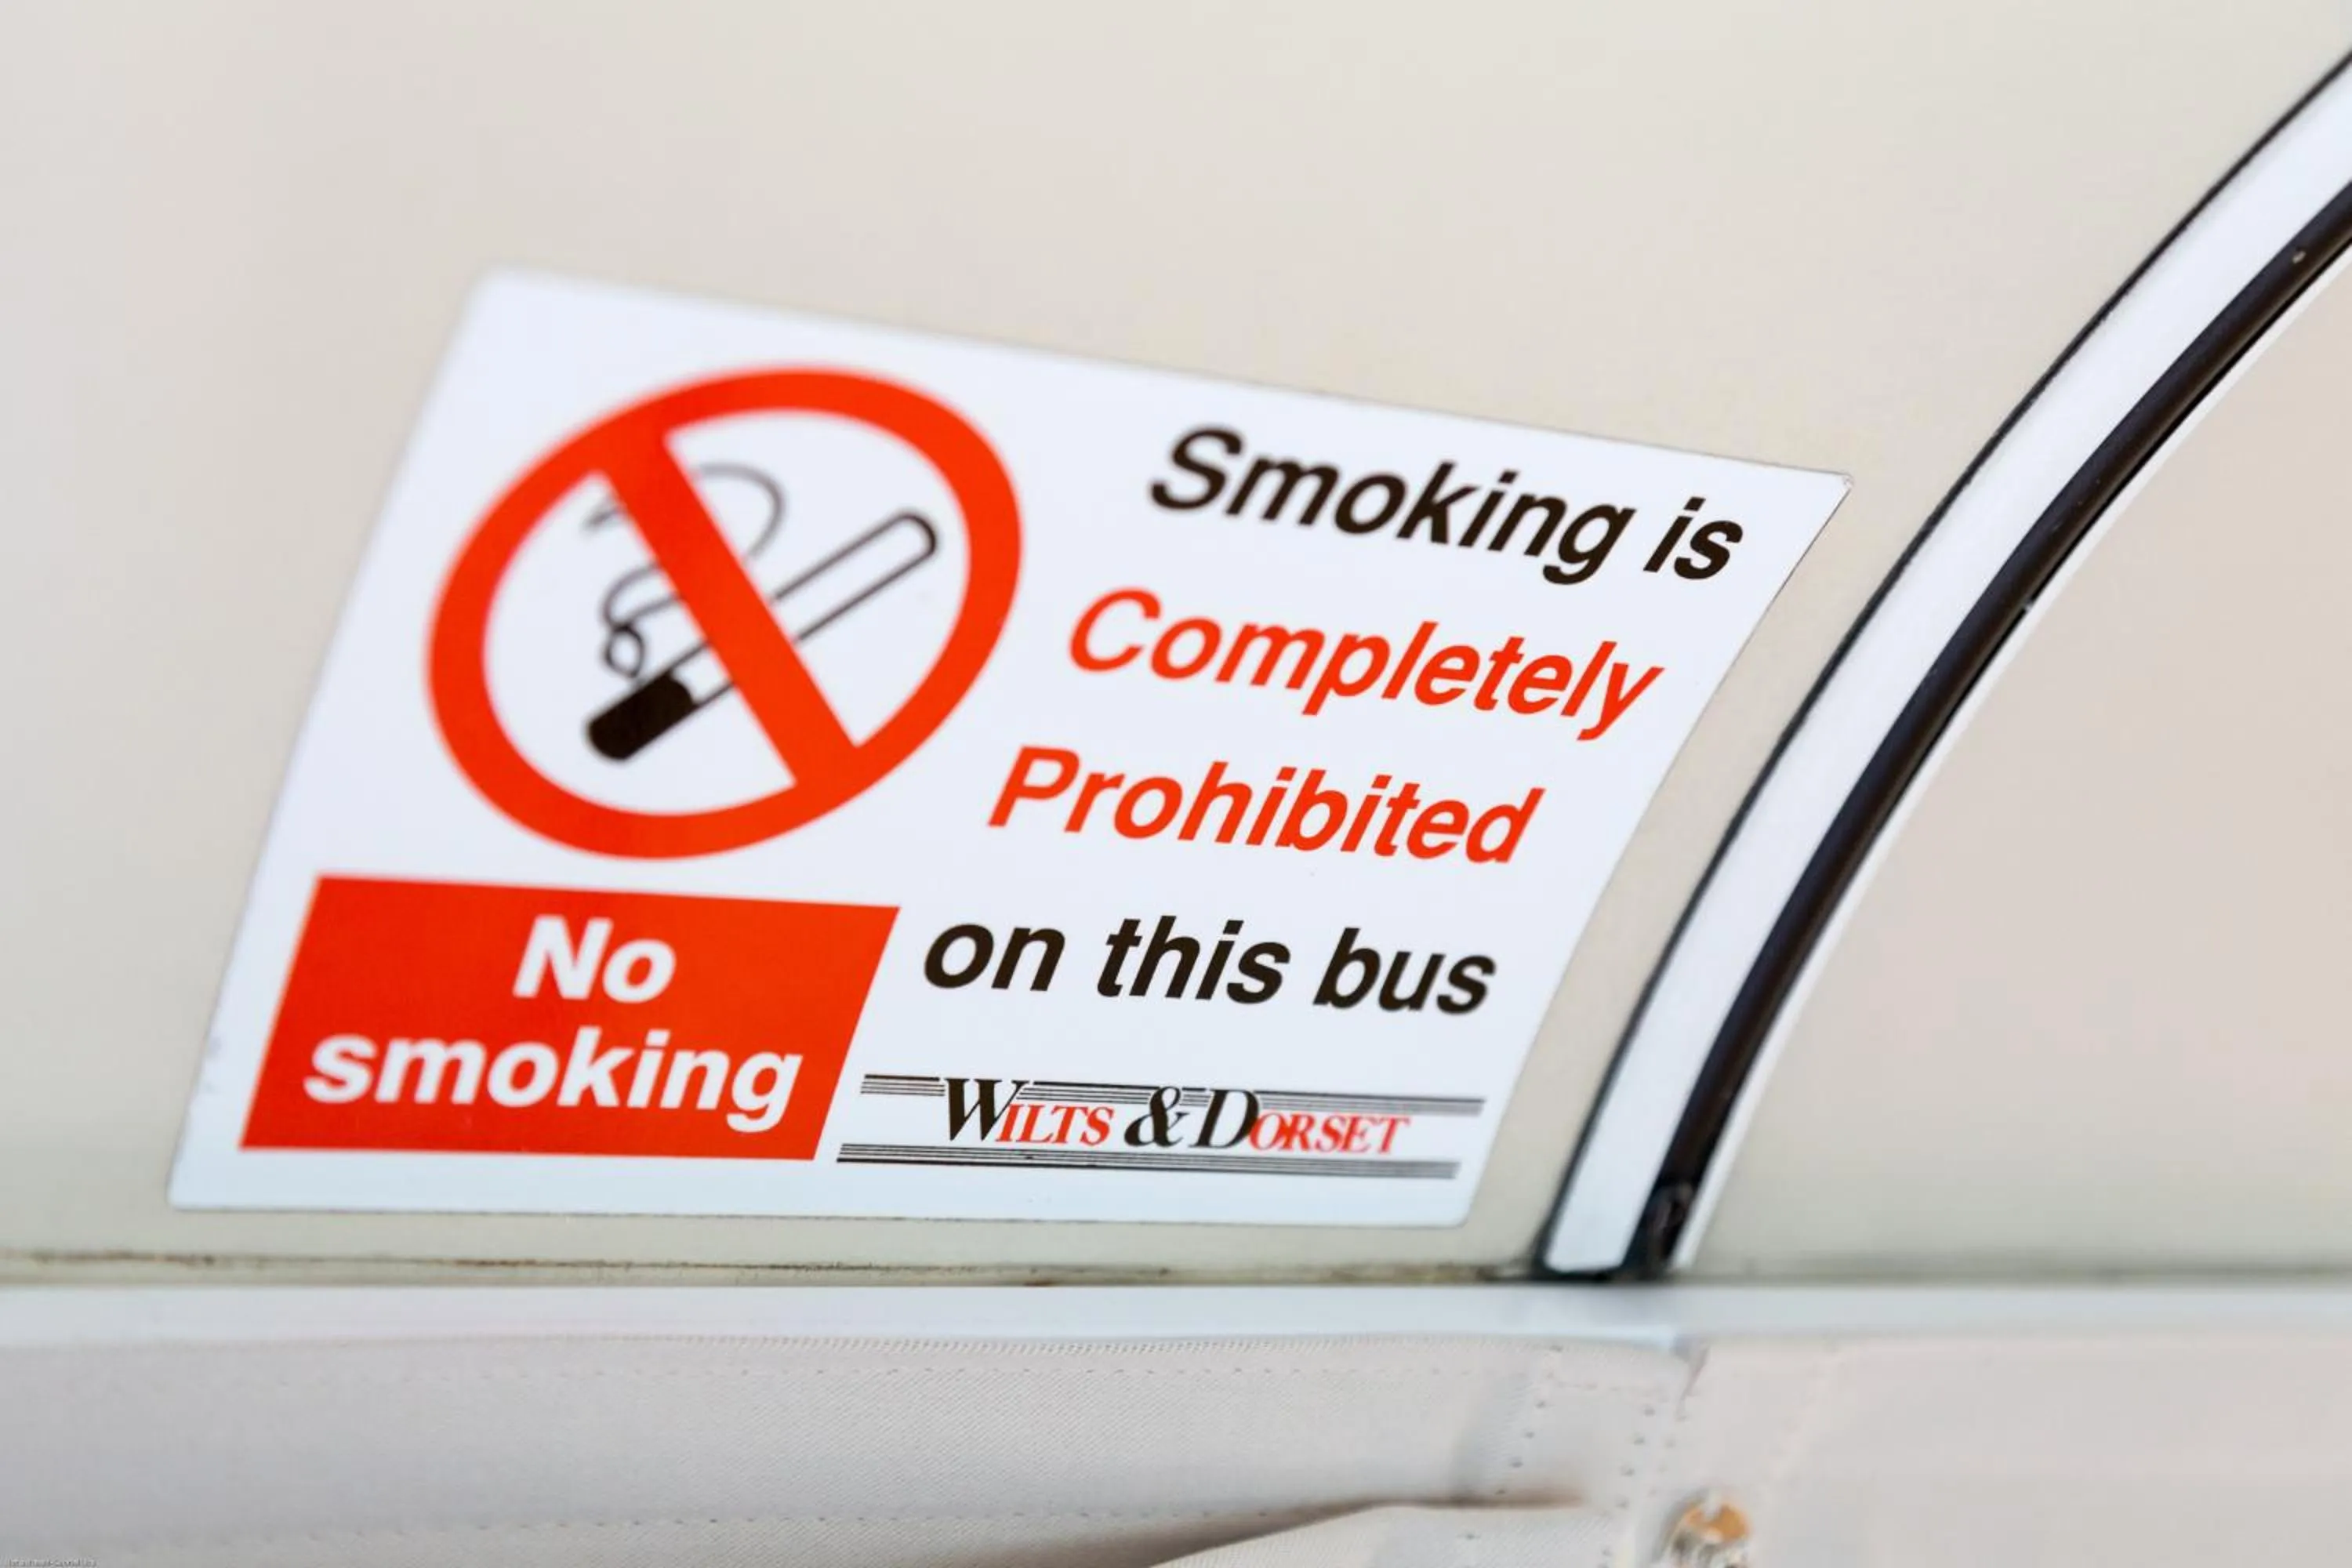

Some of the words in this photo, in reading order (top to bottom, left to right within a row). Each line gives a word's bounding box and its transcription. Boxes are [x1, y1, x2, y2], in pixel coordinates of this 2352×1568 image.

[1150, 427, 1635, 586] Smoking
[1642, 496, 1744, 580] is
[1069, 588, 1664, 741] Completely
[988, 745, 1544, 863] Prohibited
[514, 915, 675, 1003] No
[924, 924, 1065, 992] on
[1097, 917, 1290, 1004] this
[1312, 927, 1496, 1014] bus
[304, 1026, 802, 1133] smoking
[945, 1077, 1115, 1147] WILTS
[1124, 1087, 1190, 1149] &
[1189, 1088, 1410, 1153] DORSET
